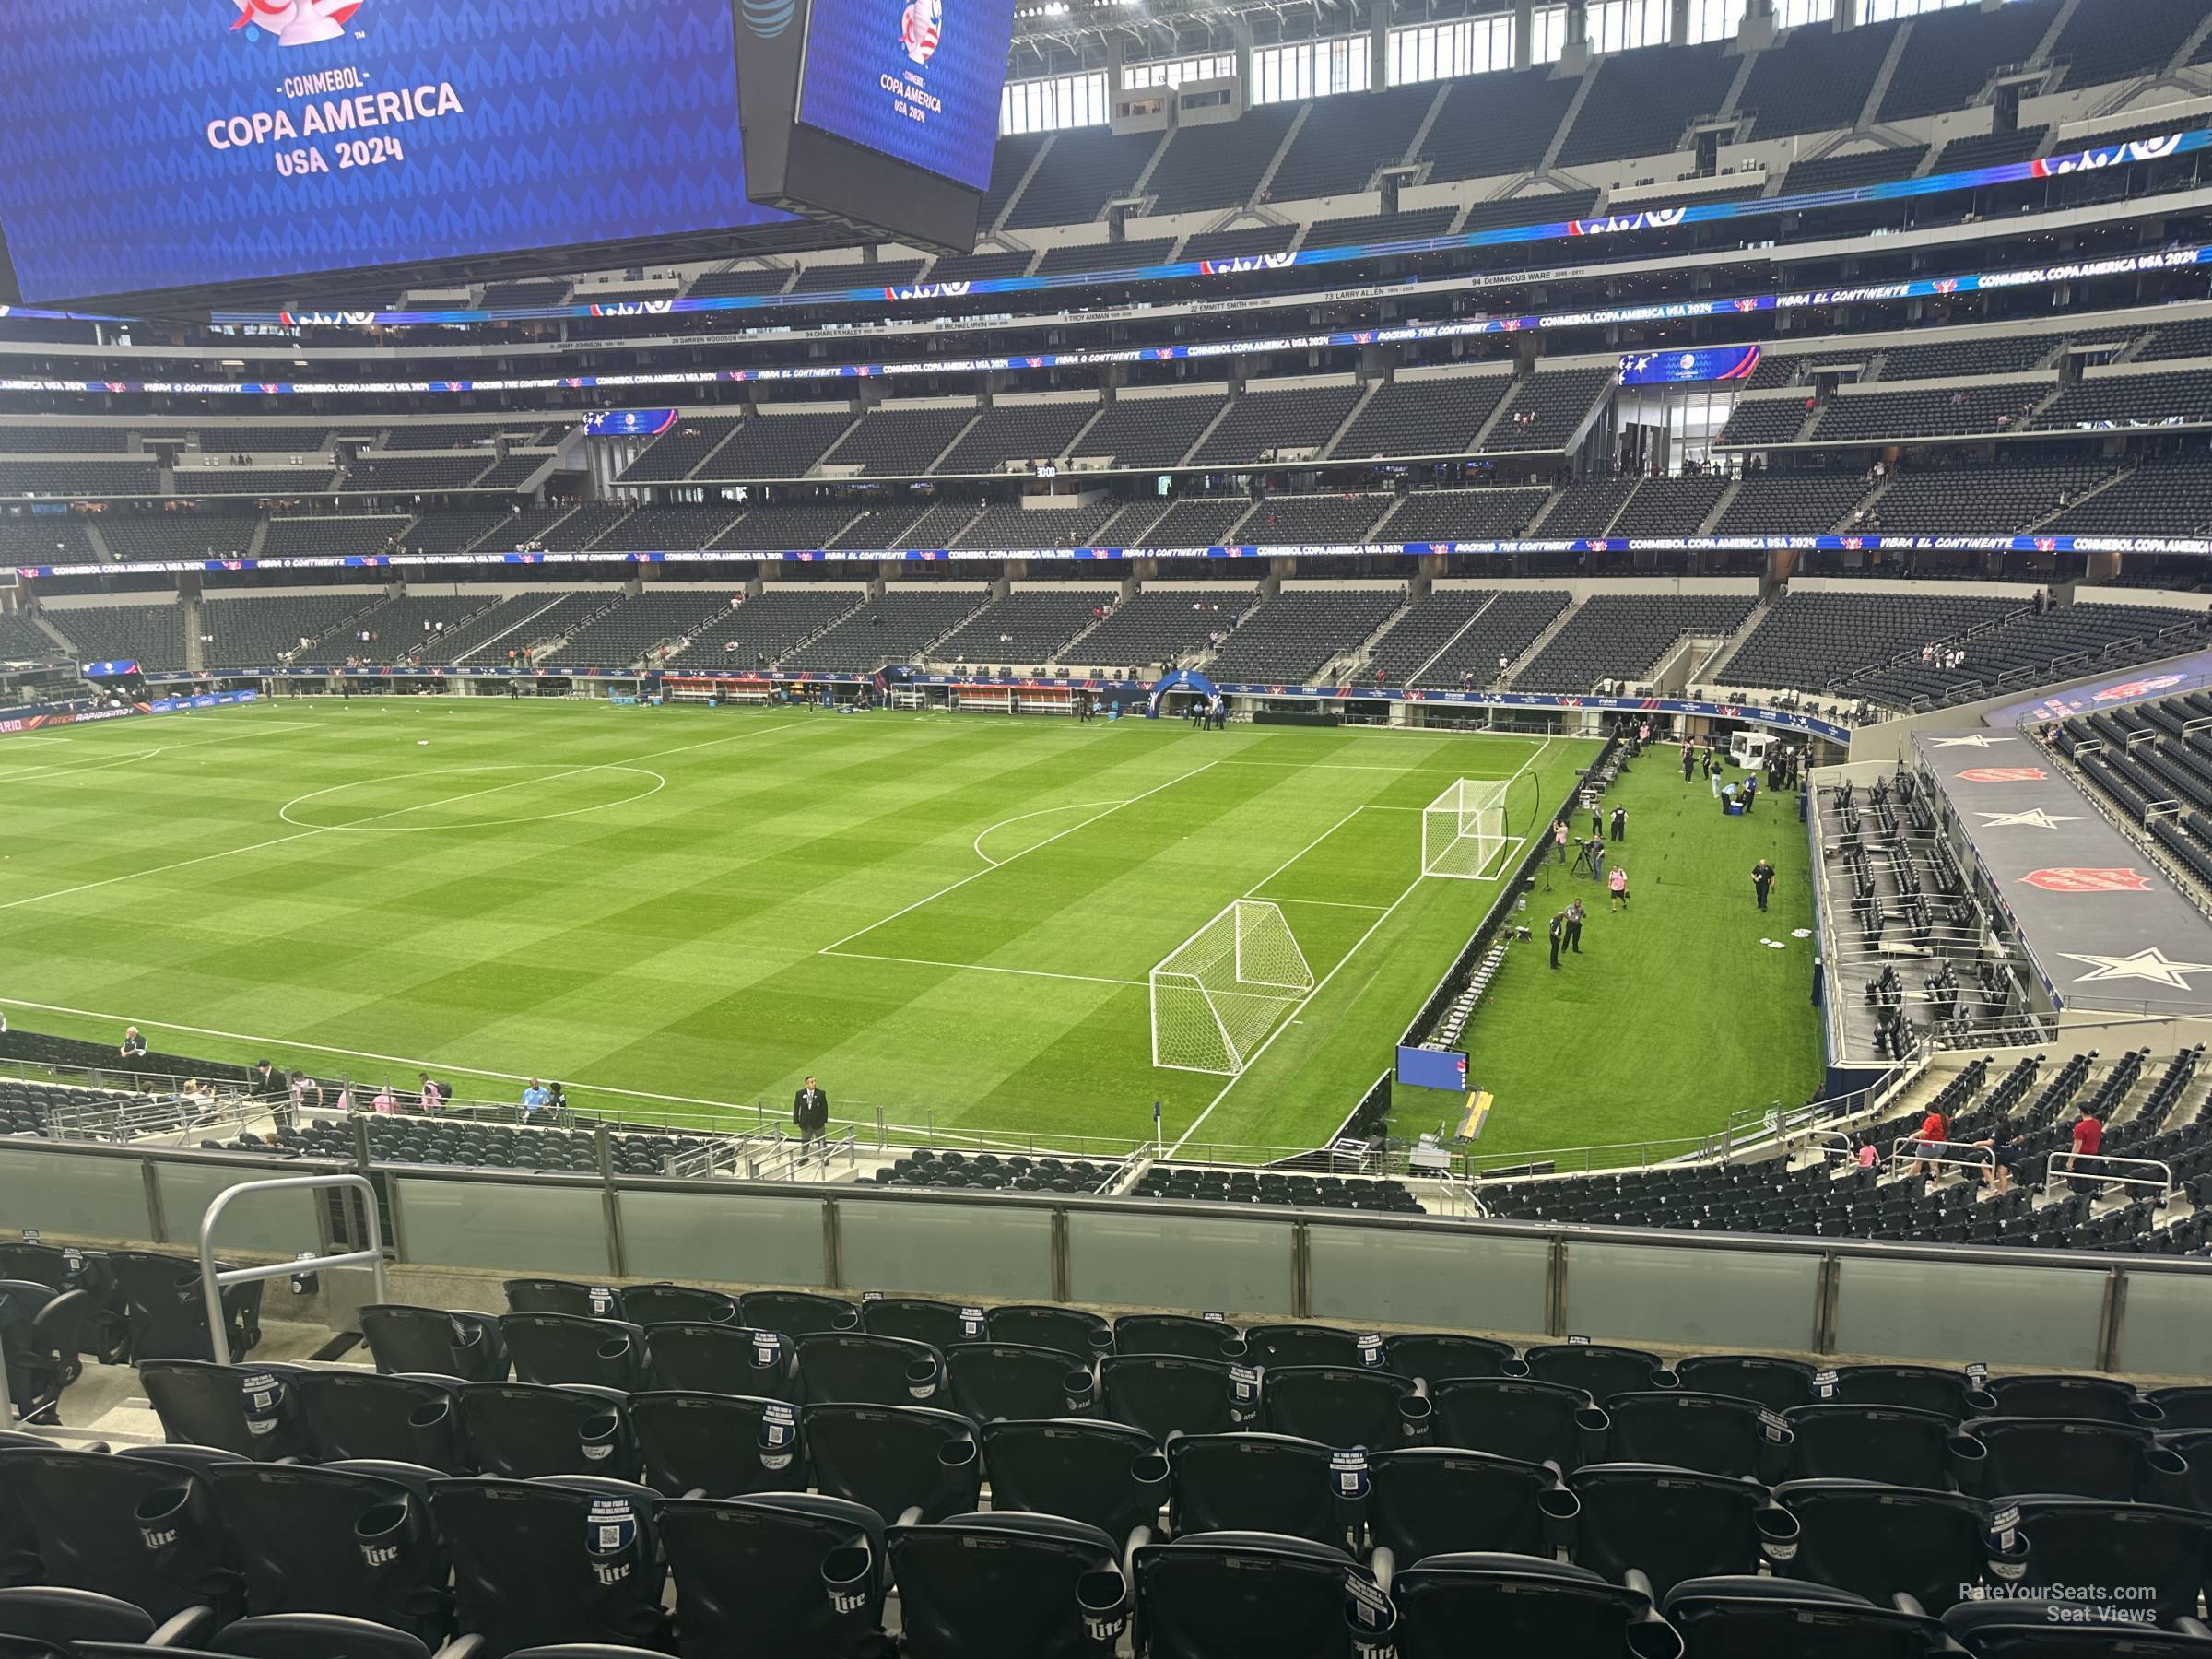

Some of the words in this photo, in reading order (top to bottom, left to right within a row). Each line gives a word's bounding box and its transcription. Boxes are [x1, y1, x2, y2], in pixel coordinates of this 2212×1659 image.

[284, 67, 364, 99] CONMEBOL
[880, 74, 903, 96] COPA
[904, 85, 941, 113] AMERICA
[207, 109, 297, 149] COPA
[302, 82, 464, 137] AMERICA
[894, 99, 907, 116] USA
[276, 147, 329, 177] USA
[335, 136, 405, 169] 2024
[1528, 272, 1551, 280] WARE
[1978, 271, 2047, 288] CONMEBOL
[2047, 266, 2079, 282] COPA
[2078, 259, 2136, 276] AMERICA
[2138, 253, 2163, 268] USA
[2166, 250, 2199, 265] 2024
[1361, 288, 1383, 297] ALLEN
[1776, 295, 1809, 307] VIBRA
[1813, 294, 1829, 304] EL
[1830, 285, 1910, 302] CONTINENTE
[1199, 303, 1225, 312] EMMITT
[1226, 301, 1247, 310] SMITH
[1539, 314, 1594, 327] CONMEBOL
[1594, 312, 1620, 323] COPA
[1619, 307, 1665, 320] AMERICA
[1666, 305, 1685, 316] USA
[1687, 303, 1712, 314] 2024
[1418, 327, 1437, 337] THE
[1187, 345, 1231, 356] CONMEBOL
[1232, 343, 1253, 353] COPA
[1252, 340, 1290, 351] AMERICA
[1292, 339, 1308, 347] USA
[1309, 336, 1329, 346] 2024
[1055, 355, 1078, 364] VIBRA
[1257, 547, 1302, 556] CONMEBOL
[1303, 547, 1325, 555] COPA
[1325, 546, 1364, 555] AMERICA
[1365, 546, 1382, 554] USA
[1382, 545, 1404, 553] 2024
[1629, 539, 1687, 549] CONMEBOL
[1688, 538, 1716, 548] COPA
[1715, 538, 1764, 548] AMERICA
[1767, 538, 1787, 548] USA
[1789, 537, 1817, 547] 2024
[1880, 538, 1913, 548] VIBRA
[1917, 538, 1933, 548] EL
[1936, 537, 2014, 548] CONTINENTE
[2073, 538, 2135, 551] CONMEBOL
[2135, 539, 2165, 551] COPA
[2165, 539, 2208, 553] AMERICA
[65, 1365, 74, 1381] 2
[584, 1448, 606, 1458] Ford
[765, 1457, 786, 1467] Ford
[139, 1527, 177, 1548] Lite
[359, 1543, 398, 1567] Lite
[591, 1561, 630, 1585] Lite
[826, 1587, 865, 1614] Lite
[1082, 1613, 1122, 1641] Lite
